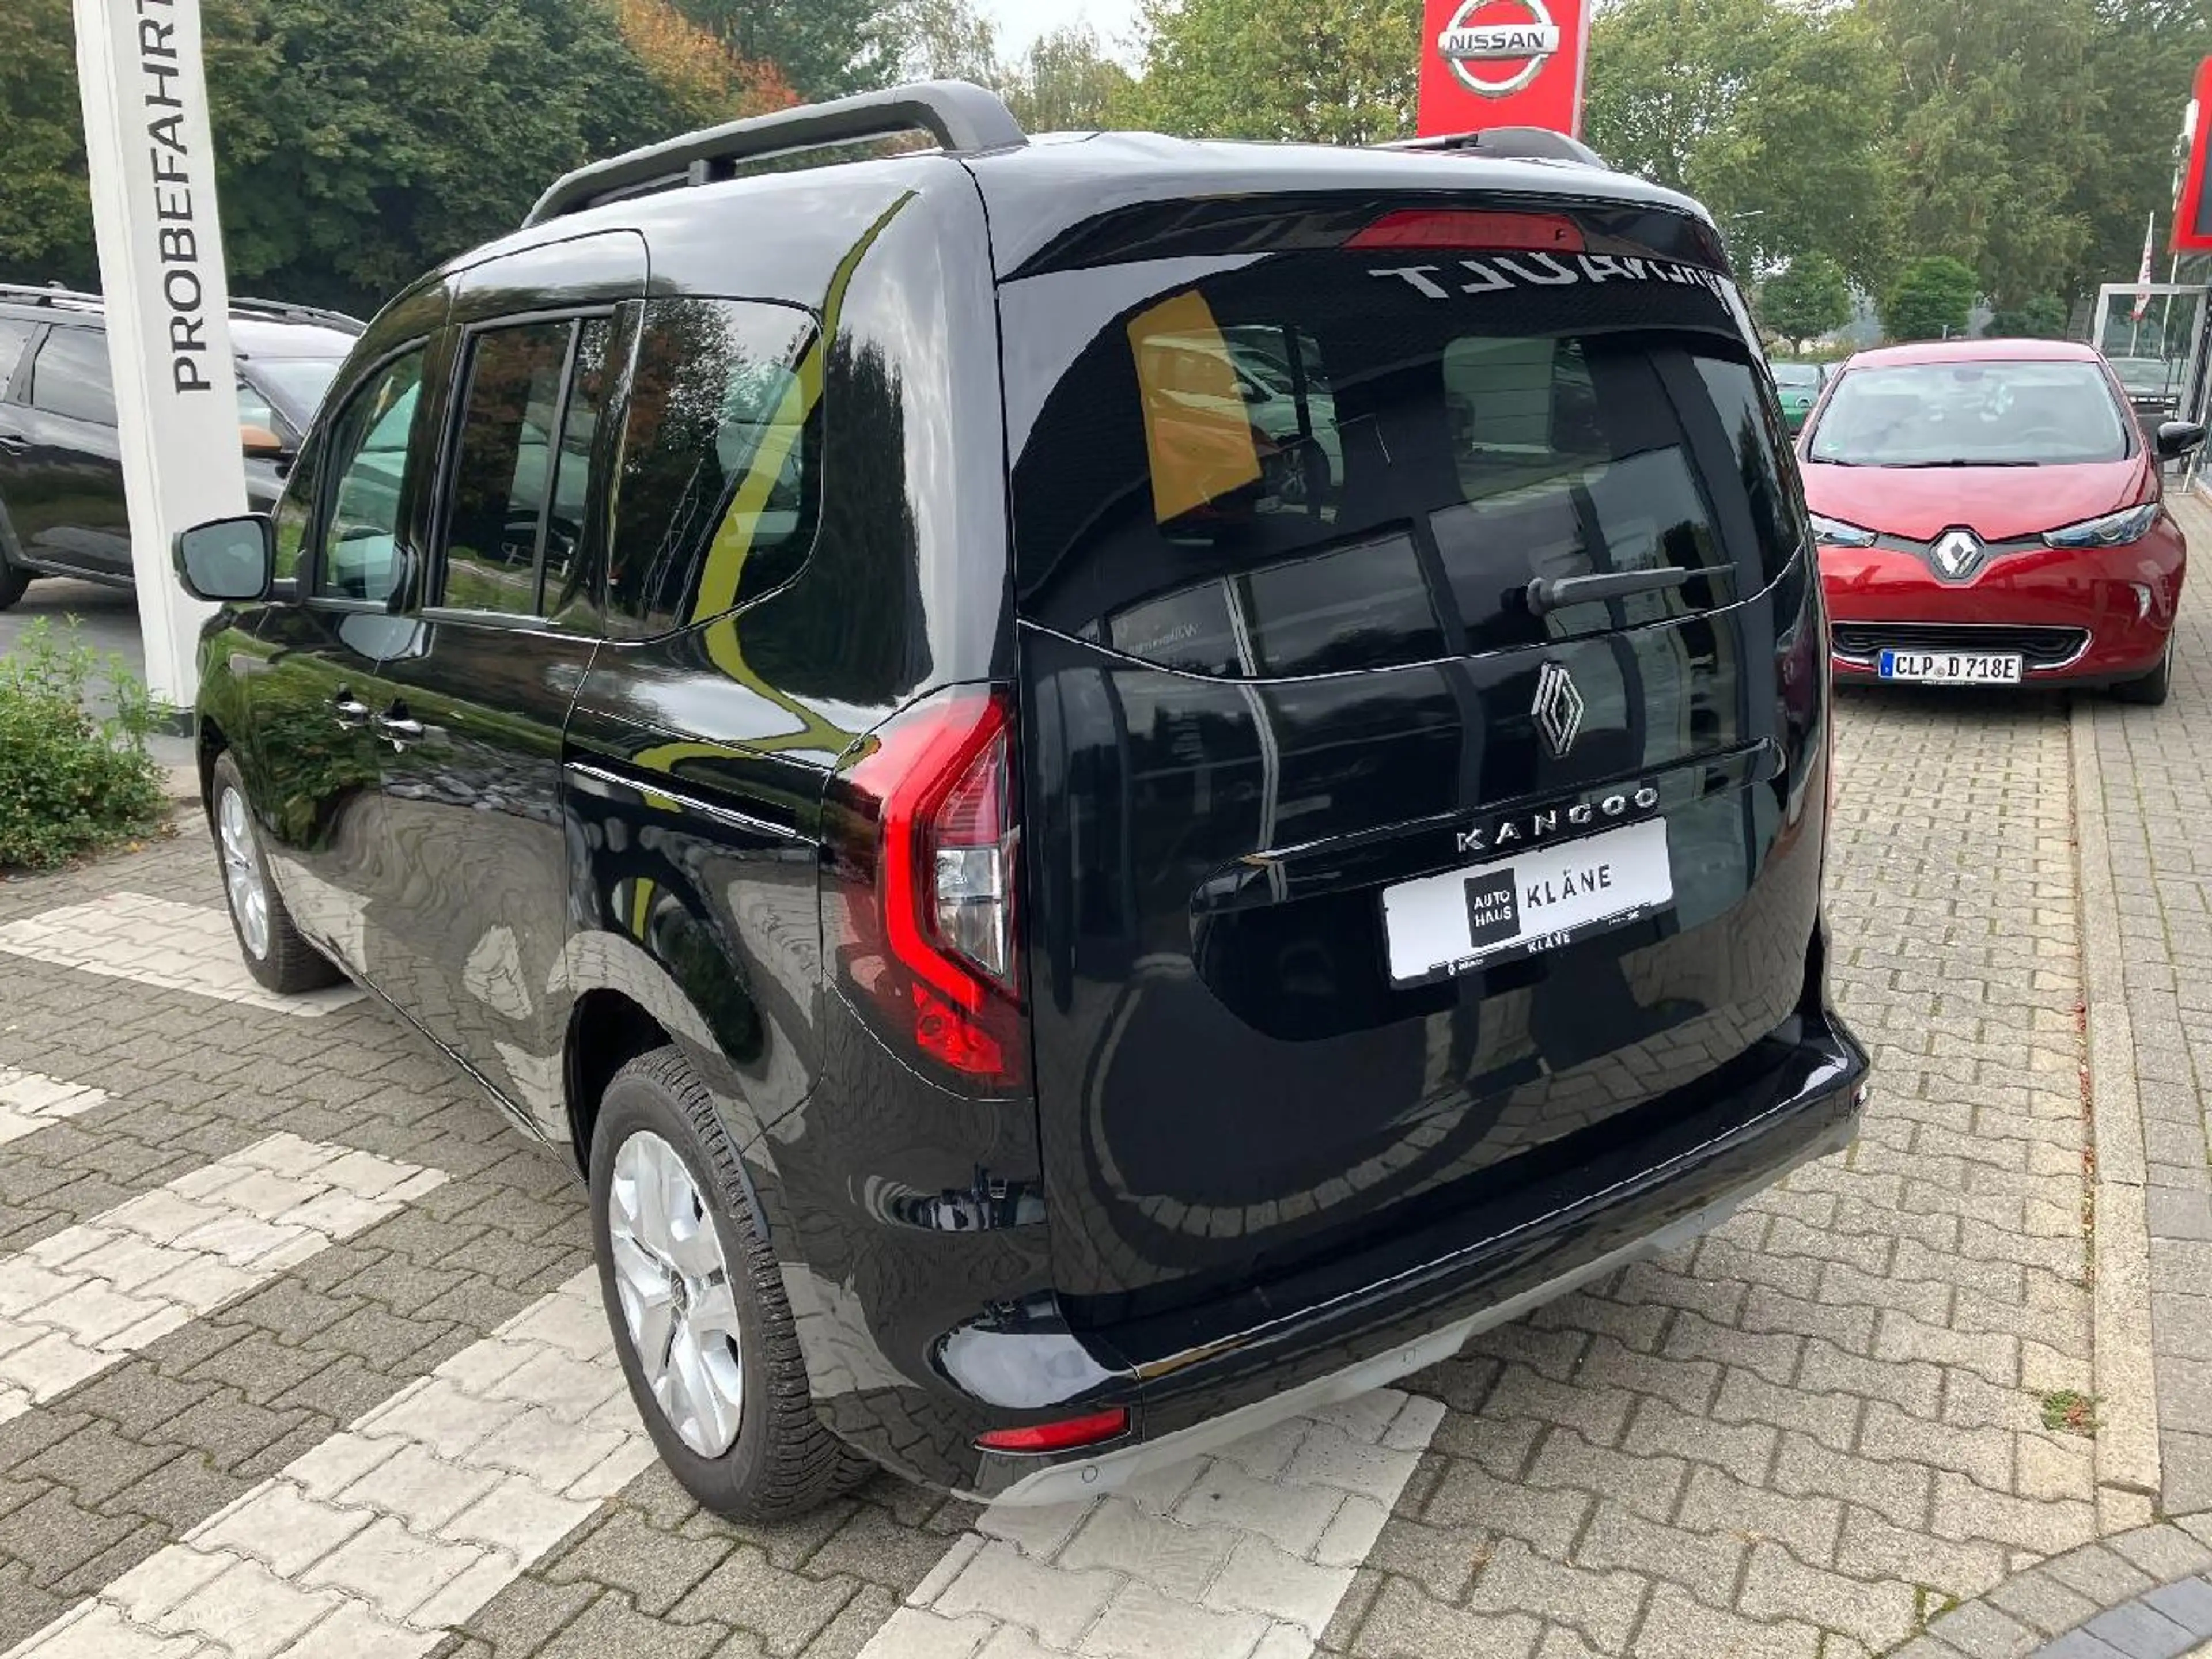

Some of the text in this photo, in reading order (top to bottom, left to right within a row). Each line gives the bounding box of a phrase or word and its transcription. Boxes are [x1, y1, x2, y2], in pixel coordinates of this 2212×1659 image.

[1449, 32, 1544, 50] NISSAN
[1896, 656, 2016, 678] CLP D 718E
[1457, 787, 1659, 853] KANGOO
[1527, 864, 1612, 908] KLÄNE
[1474, 889, 1510, 911] AUTO
[1475, 906, 1512, 927] HAUS
